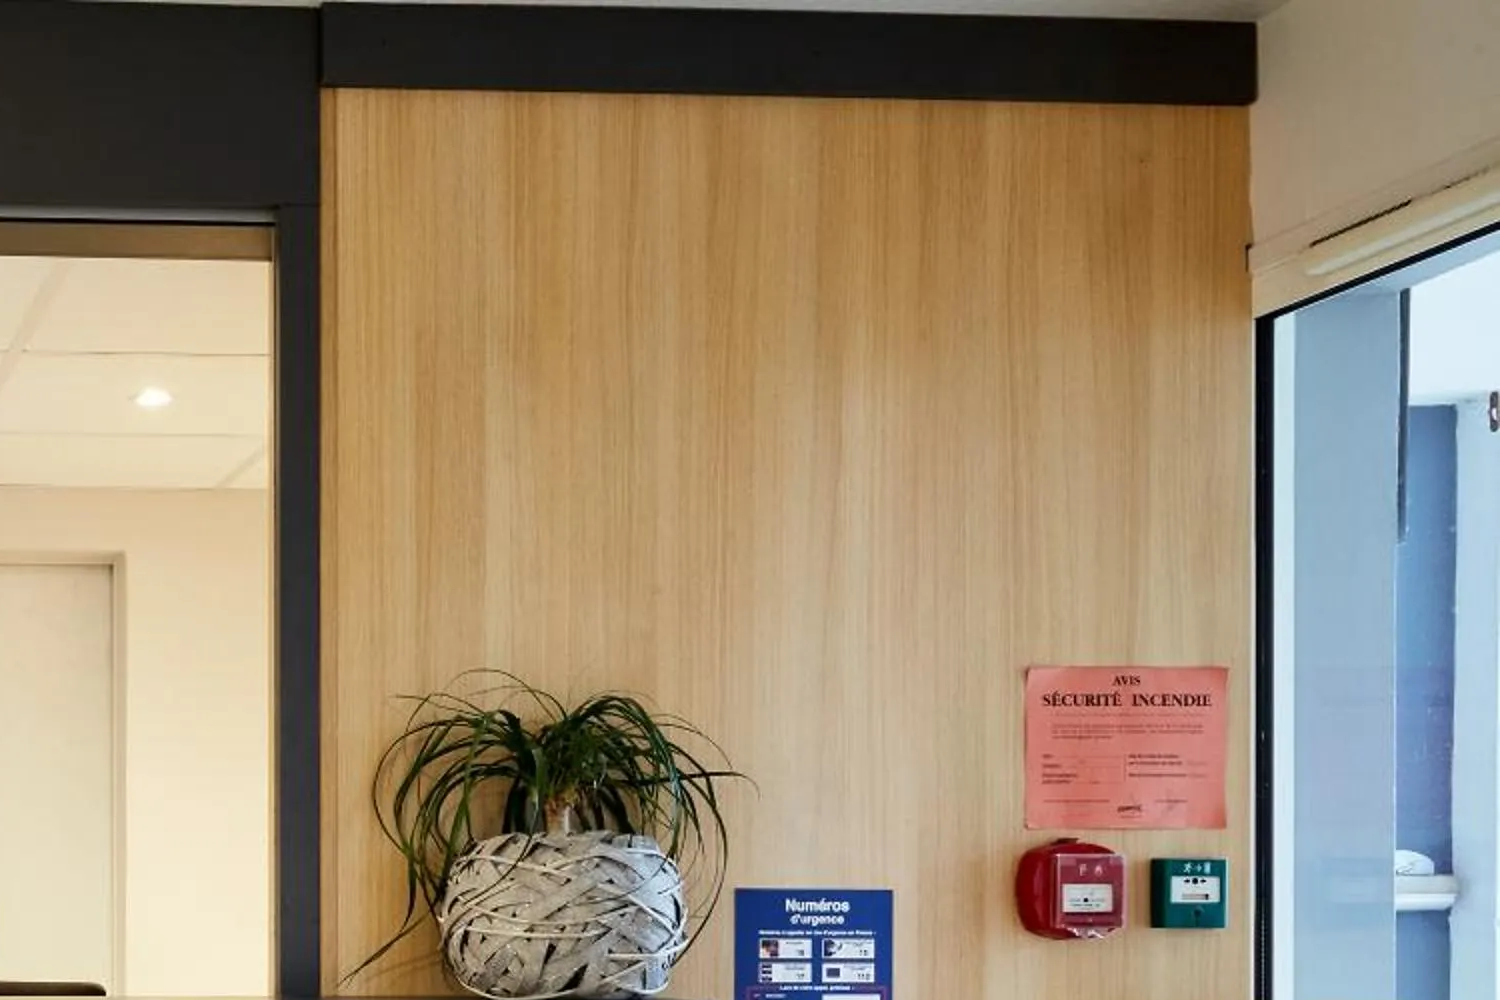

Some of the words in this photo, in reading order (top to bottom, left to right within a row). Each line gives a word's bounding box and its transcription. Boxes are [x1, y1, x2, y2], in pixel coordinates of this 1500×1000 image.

[1112, 675, 1141, 686] AVIS
[1042, 690, 1122, 707] SÉCURITÉ
[1131, 694, 1212, 707] INCENDIE
[785, 898, 850, 913] Numéros
[790, 914, 845, 927] d'urgence
